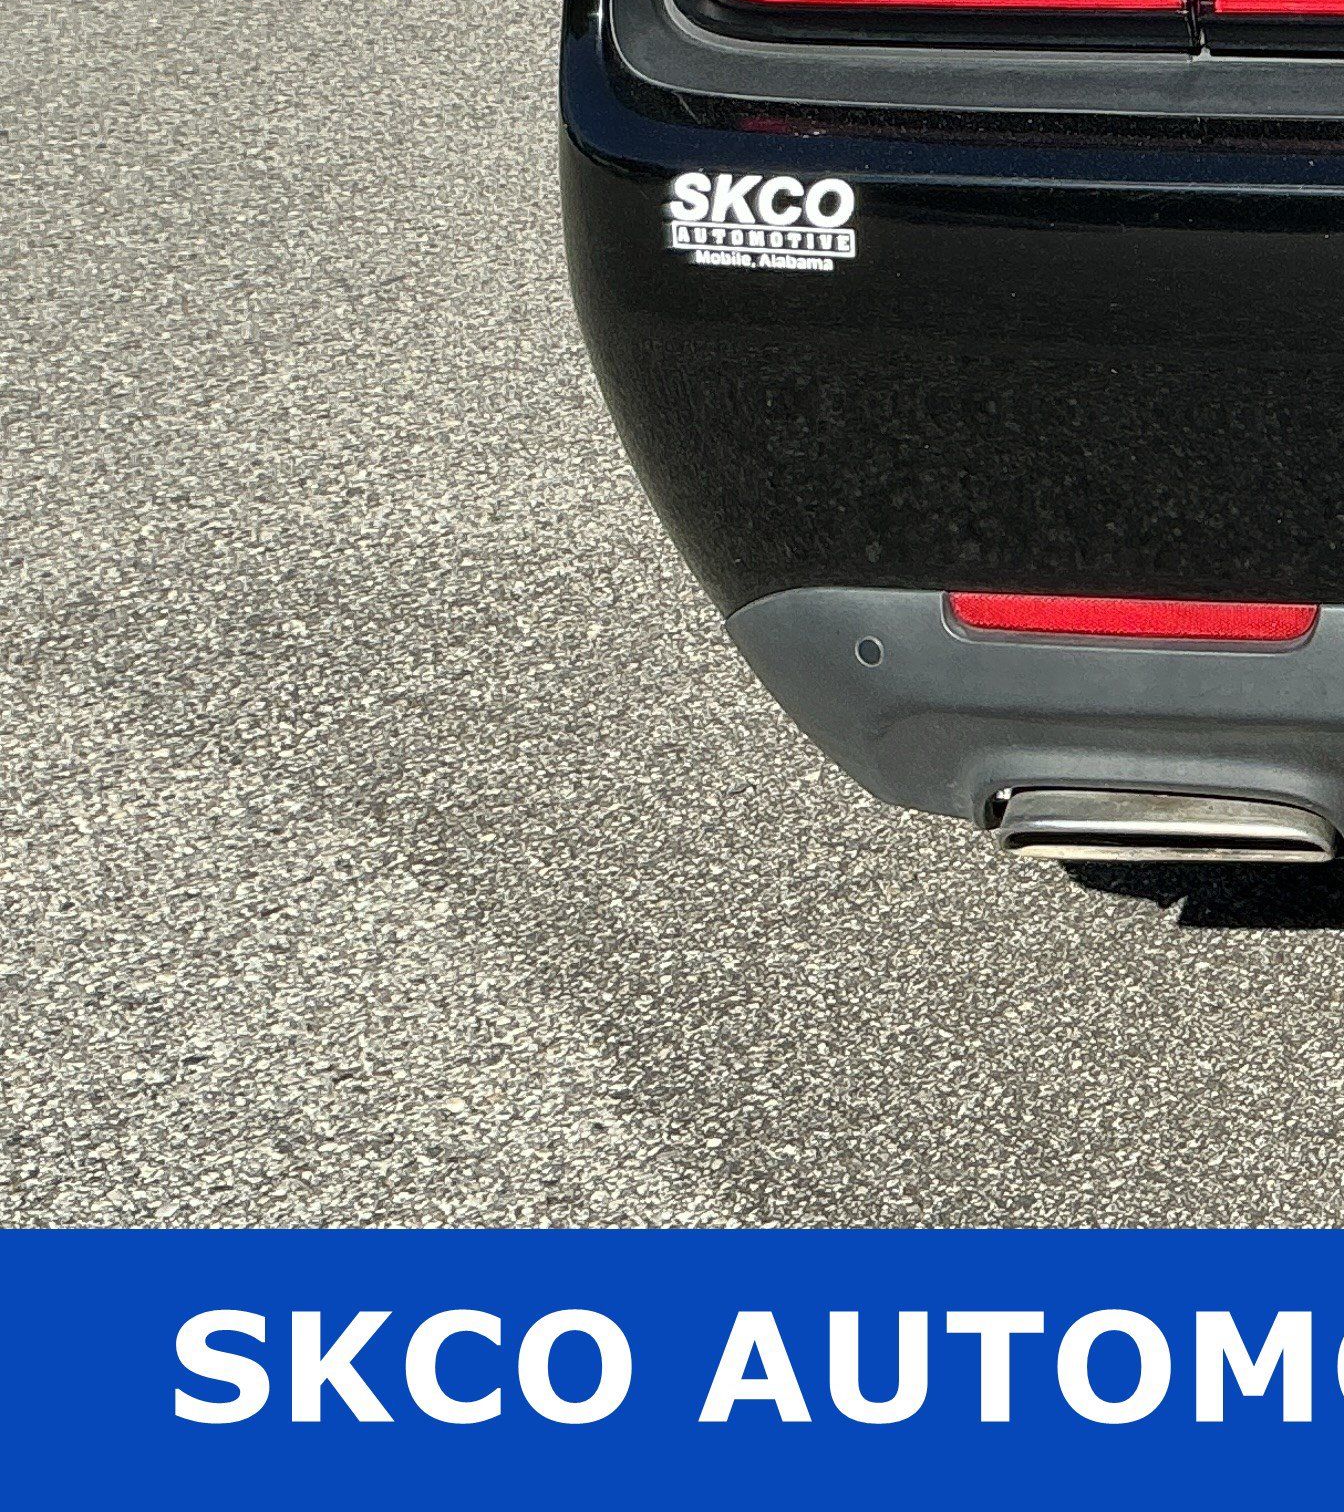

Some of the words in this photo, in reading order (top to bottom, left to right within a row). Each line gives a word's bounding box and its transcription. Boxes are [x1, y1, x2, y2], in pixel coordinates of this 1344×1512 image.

[669, 172, 856, 228] SKCO
[677, 226, 852, 251] AUTOMOTIVE
[694, 250, 757, 269] Mobile,
[759, 253, 834, 272] Alabama
